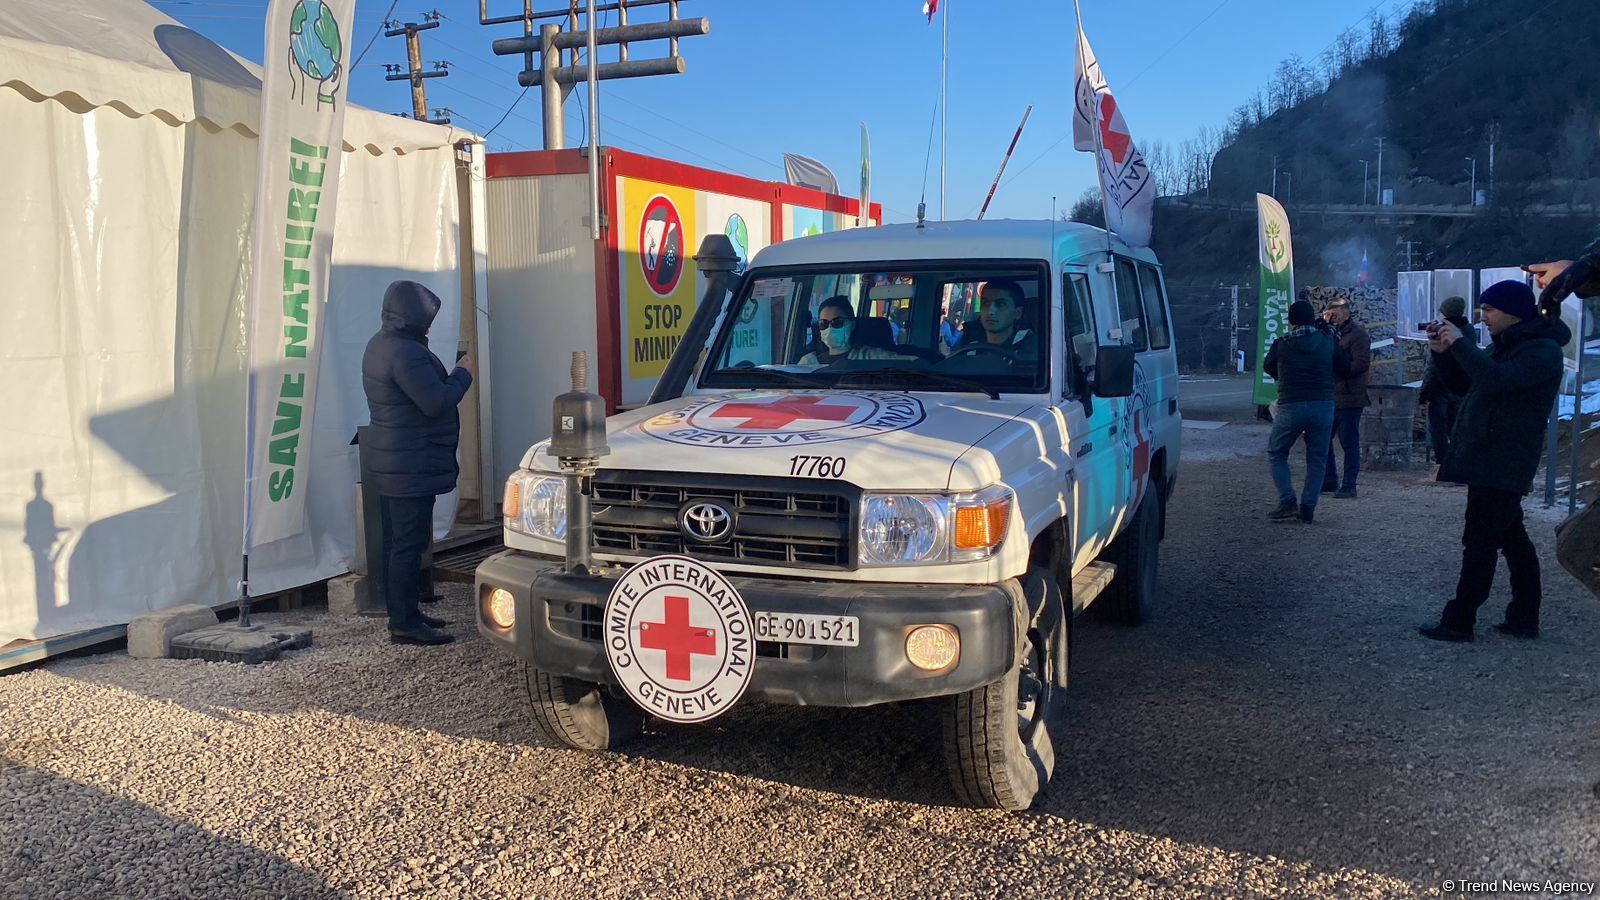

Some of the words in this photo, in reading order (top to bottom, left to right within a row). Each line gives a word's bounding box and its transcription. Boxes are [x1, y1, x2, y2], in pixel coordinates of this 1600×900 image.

[283, 136, 328, 358] NATURE!
[644, 304, 682, 330] STOP
[634, 335, 682, 362] MININ
[268, 373, 304, 502] SAVE
[668, 429, 828, 445] GENEVE
[789, 455, 846, 478] 17760
[611, 582, 638, 669] COMITE
[638, 563, 747, 679] INTERNATIONAL
[638, 680, 722, 715] GENEVE
